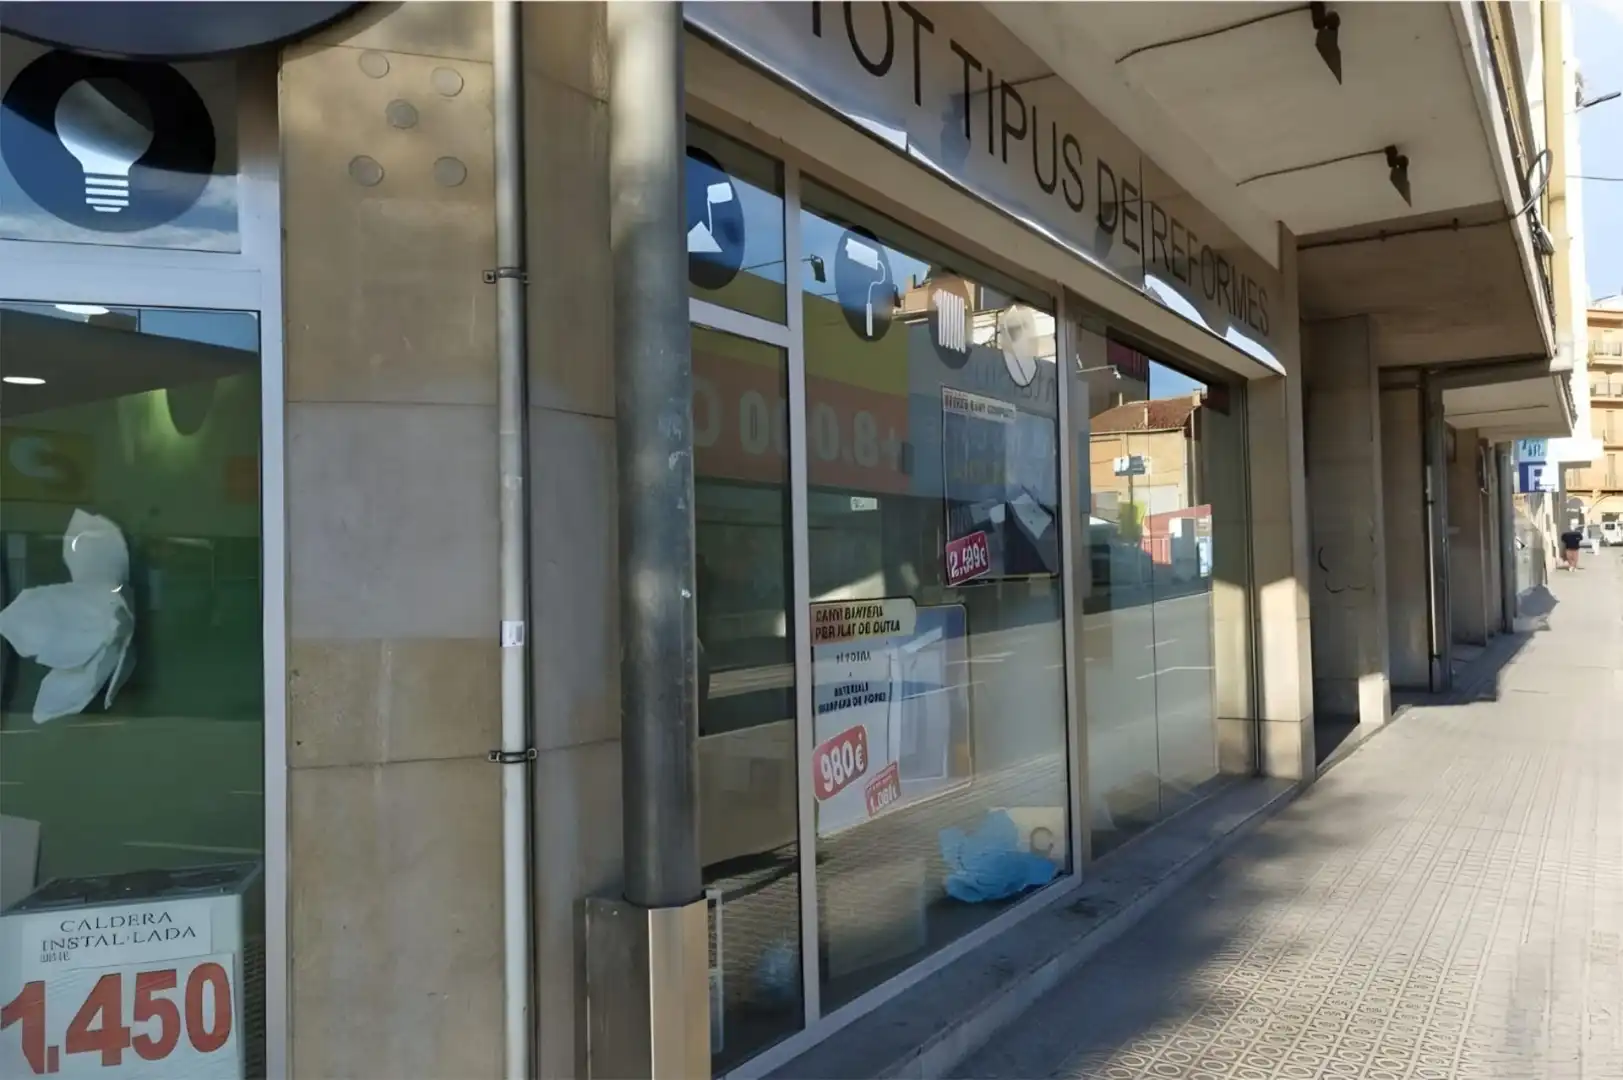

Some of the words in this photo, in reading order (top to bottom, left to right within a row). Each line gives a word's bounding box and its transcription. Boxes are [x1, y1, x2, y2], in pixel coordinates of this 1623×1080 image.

[949, 38, 1085, 213] TIPUS
[1097, 157, 1140, 255] DE
[1151, 200, 1269, 338] REFORMES
[60, 911, 173, 932] CALDERA
[0, 962, 232, 1075] 1.450
